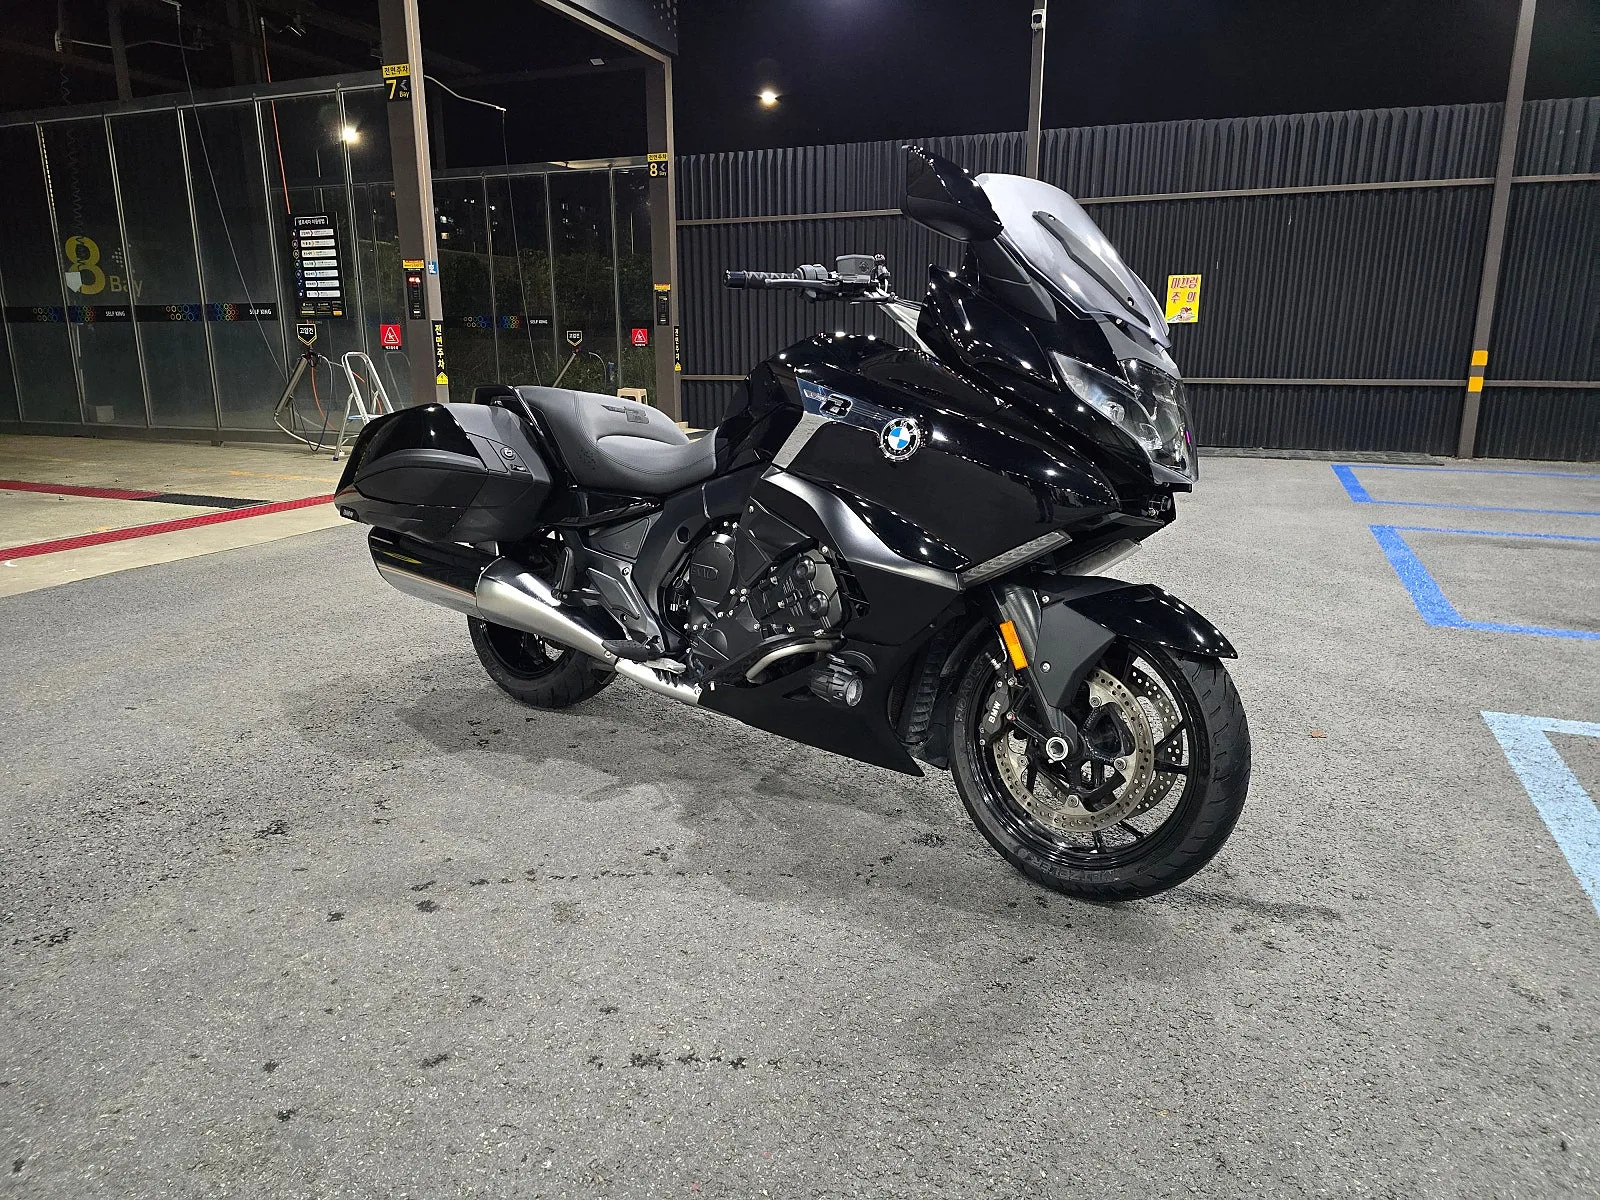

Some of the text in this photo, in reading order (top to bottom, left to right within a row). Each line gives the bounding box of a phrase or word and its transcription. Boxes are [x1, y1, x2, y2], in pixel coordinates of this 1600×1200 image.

[384, 65, 408, 76] 전면주차
[385, 79, 397, 100] 7
[399, 90, 410, 99] Bay
[649, 162, 658, 177] 8
[64, 235, 106, 295] 8
[109, 275, 143, 298] Bay
[1171, 276, 1199, 289] 미끄럼
[434, 324, 446, 370] 전면주차
[988, 700, 1001, 724] BMW
